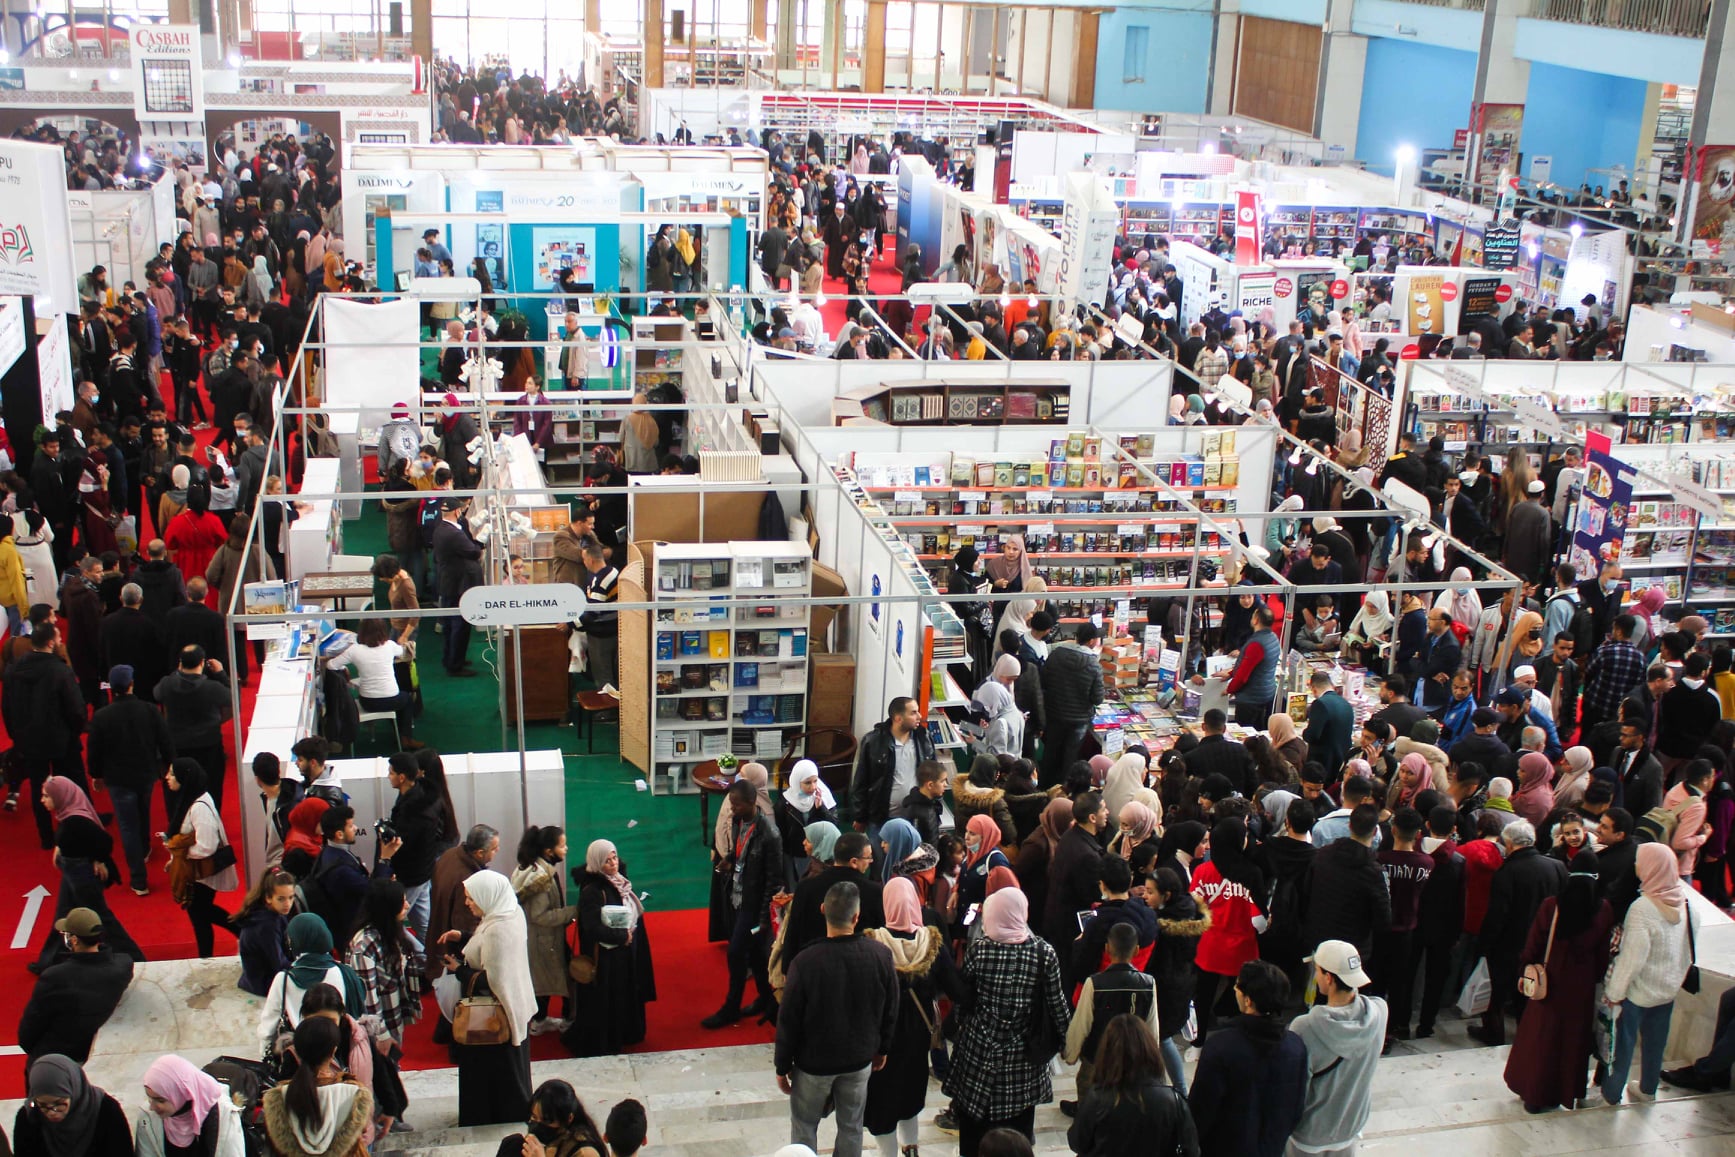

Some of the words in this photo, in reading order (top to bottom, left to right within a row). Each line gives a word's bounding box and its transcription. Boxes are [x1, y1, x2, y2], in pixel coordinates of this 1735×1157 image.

[136, 29, 190, 48] CASBAH
[146, 44, 191, 54] Editions
[358, 178, 404, 188] DALIM
[557, 196, 575, 207] 20
[1485, 238, 1519, 248] العناوين
[1242, 297, 1272, 306] RICHE
[485, 601, 506, 609] DAR
[509, 599, 558, 608] EL-HIKMA
[1386, 864, 1413, 880] TIAN
